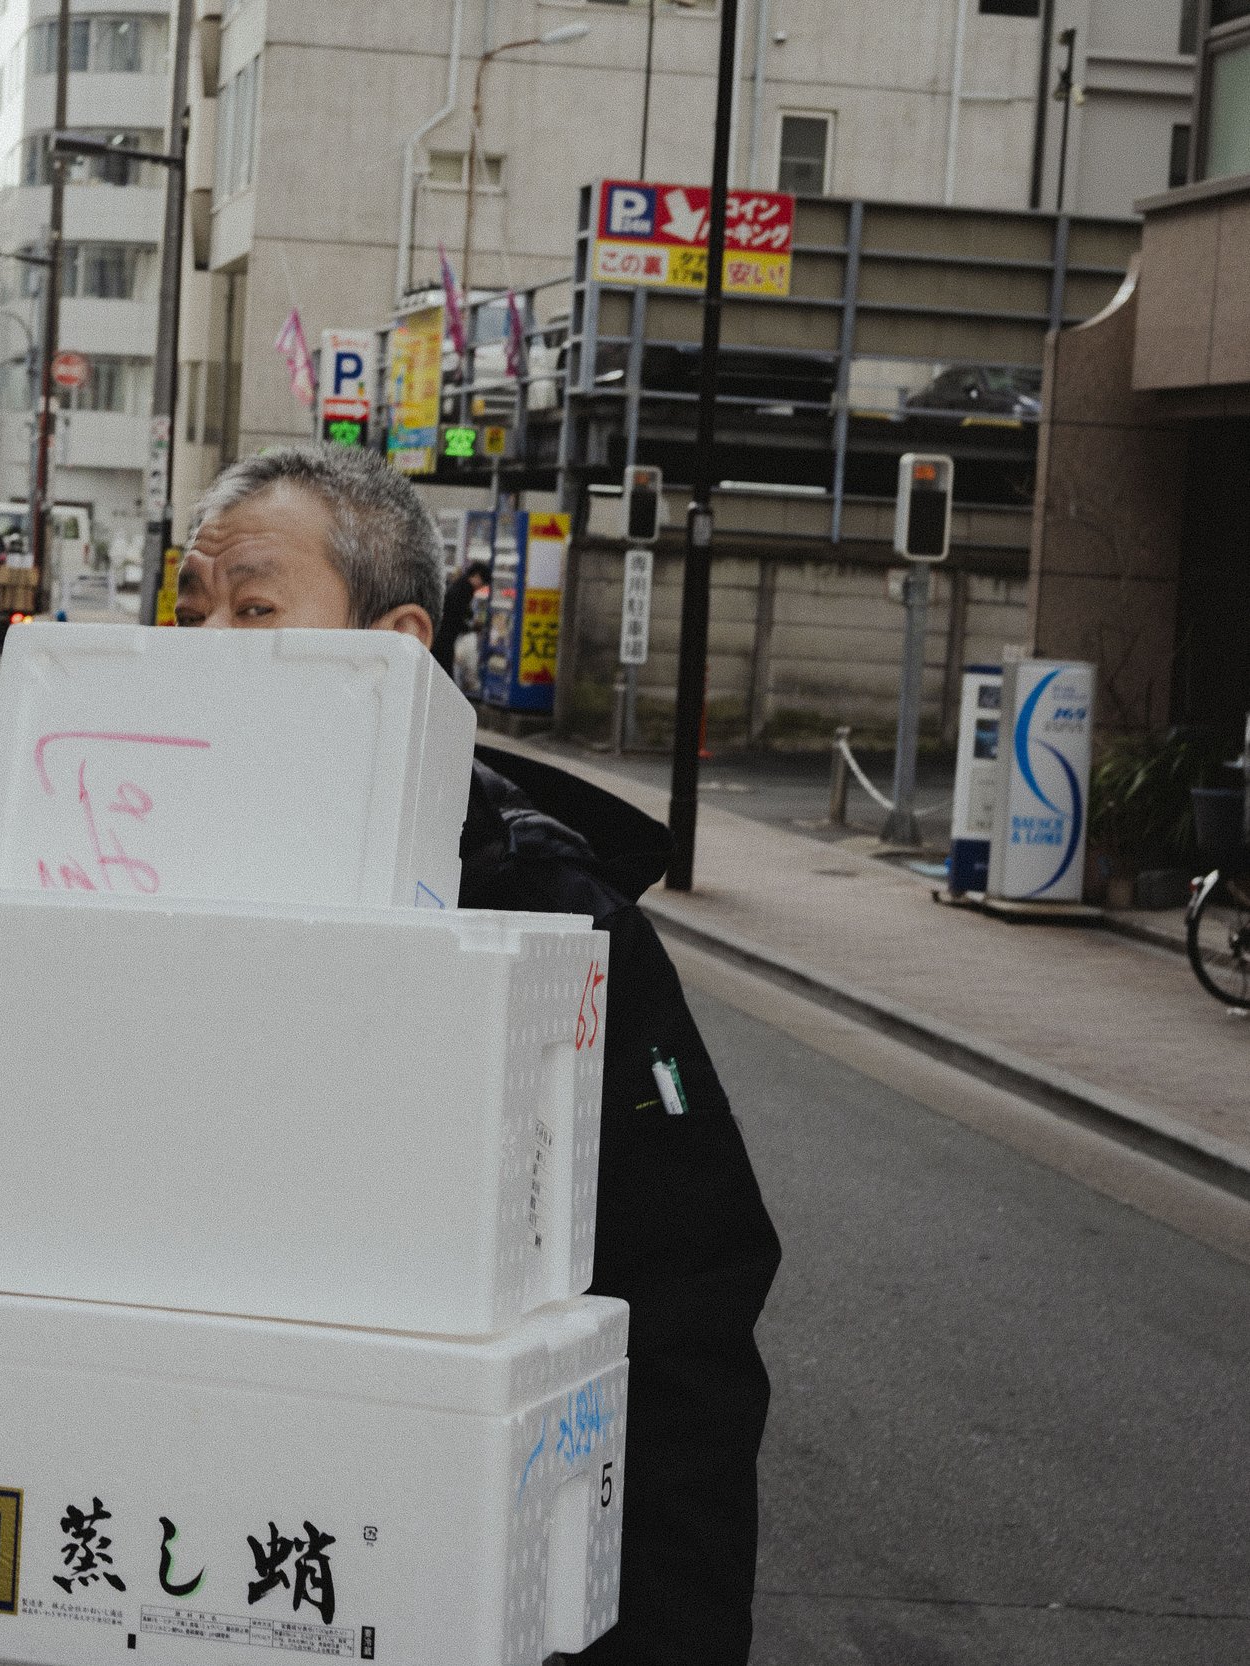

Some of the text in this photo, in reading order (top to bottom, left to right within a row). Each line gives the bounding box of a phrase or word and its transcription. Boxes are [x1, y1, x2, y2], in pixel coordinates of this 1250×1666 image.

[601, 250, 662, 277] この裏
[333, 352, 363, 395] P
[600, 1461, 613, 1508] 5
[52, 1496, 337, 1626] 蒸し蛸
